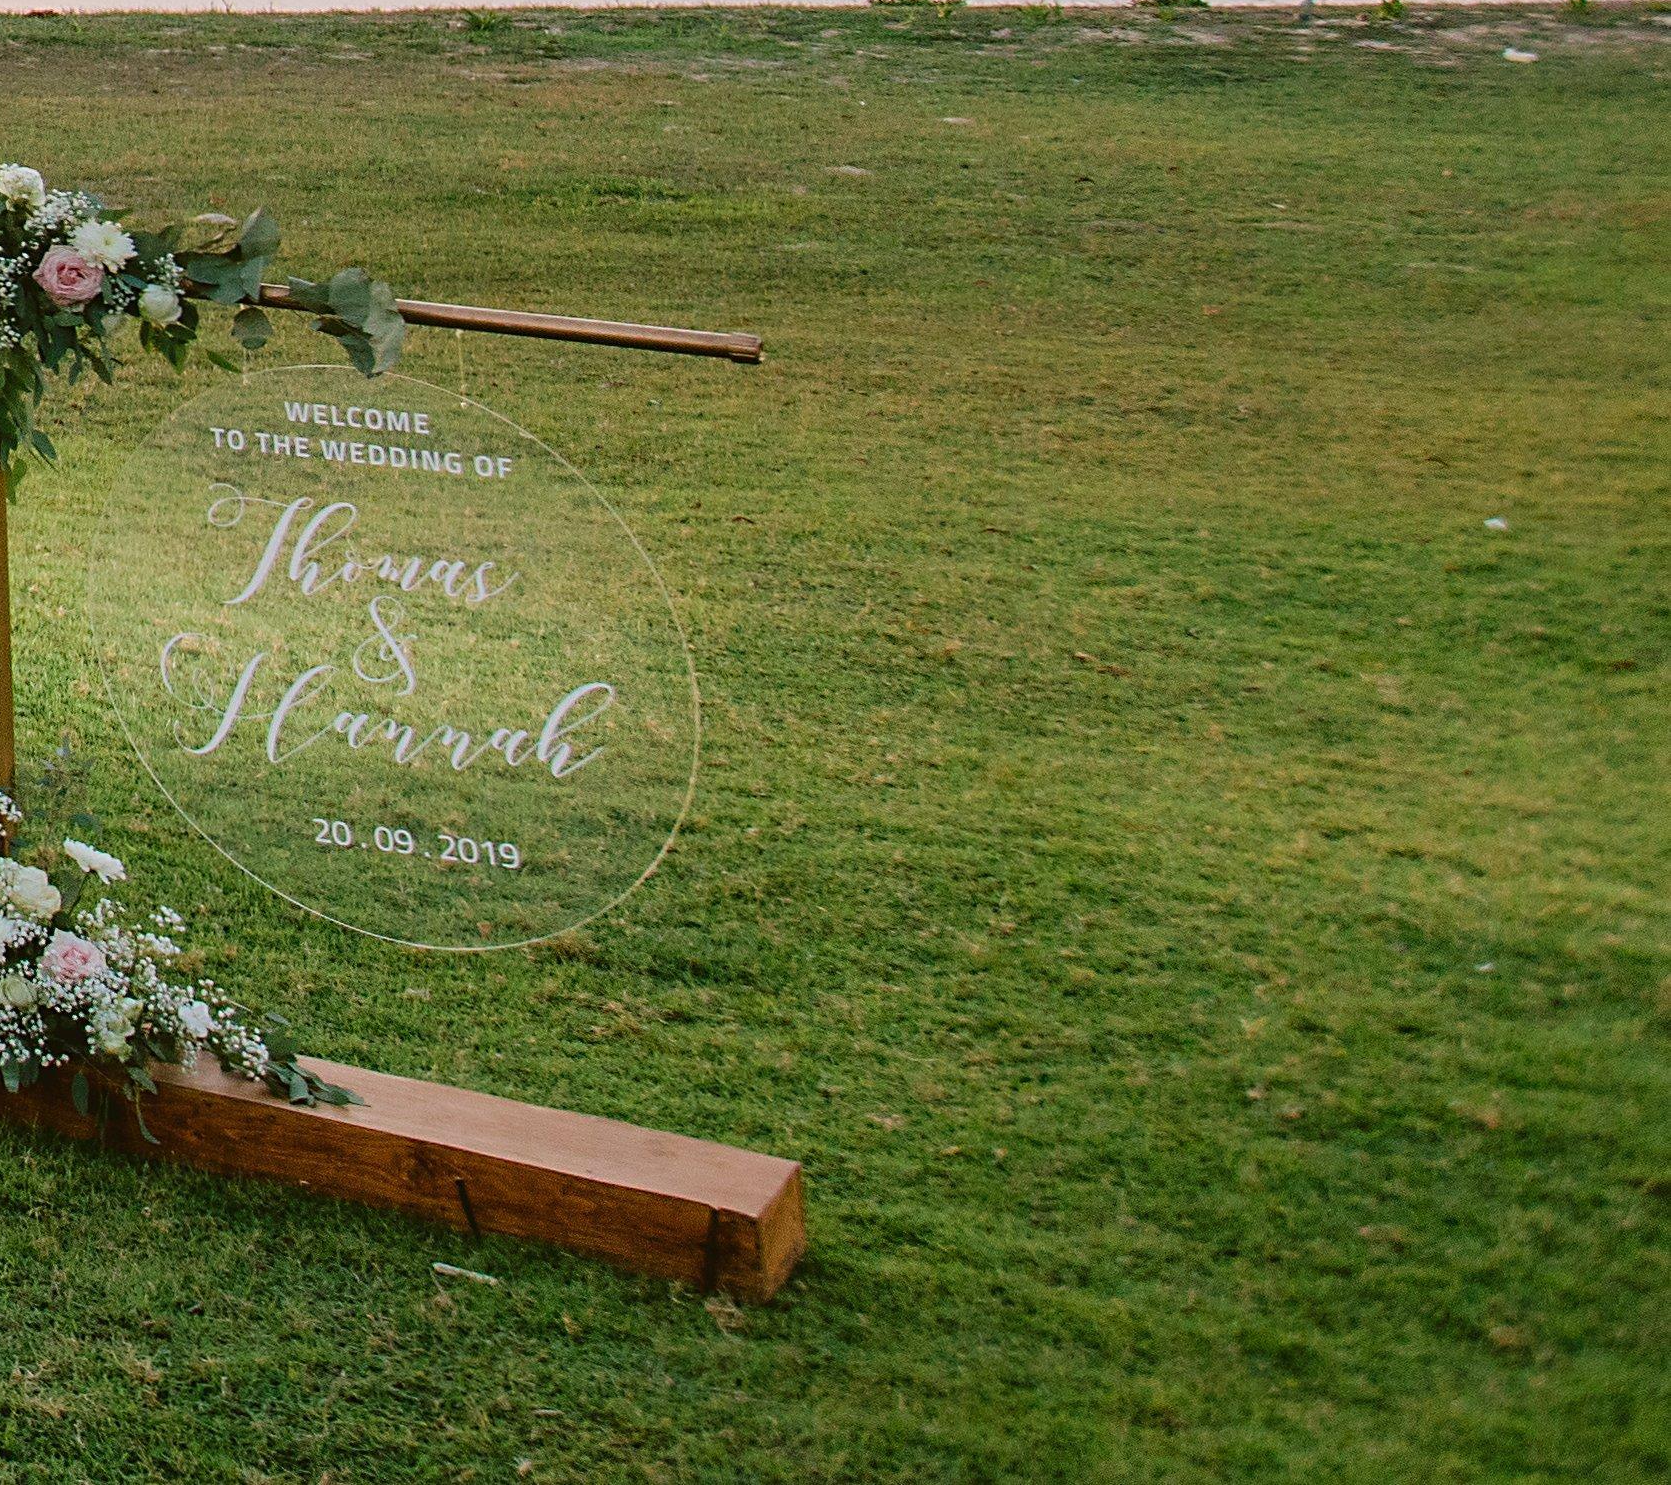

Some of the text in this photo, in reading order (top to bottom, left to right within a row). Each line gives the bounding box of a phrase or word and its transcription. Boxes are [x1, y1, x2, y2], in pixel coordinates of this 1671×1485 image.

[209, 427, 513, 479] TO THE WEDDING OF
[284, 400, 431, 436] WELCOME
[207, 482, 521, 606] Thomas
[352, 595, 419, 697] &
[159, 631, 617, 779] Hannah
